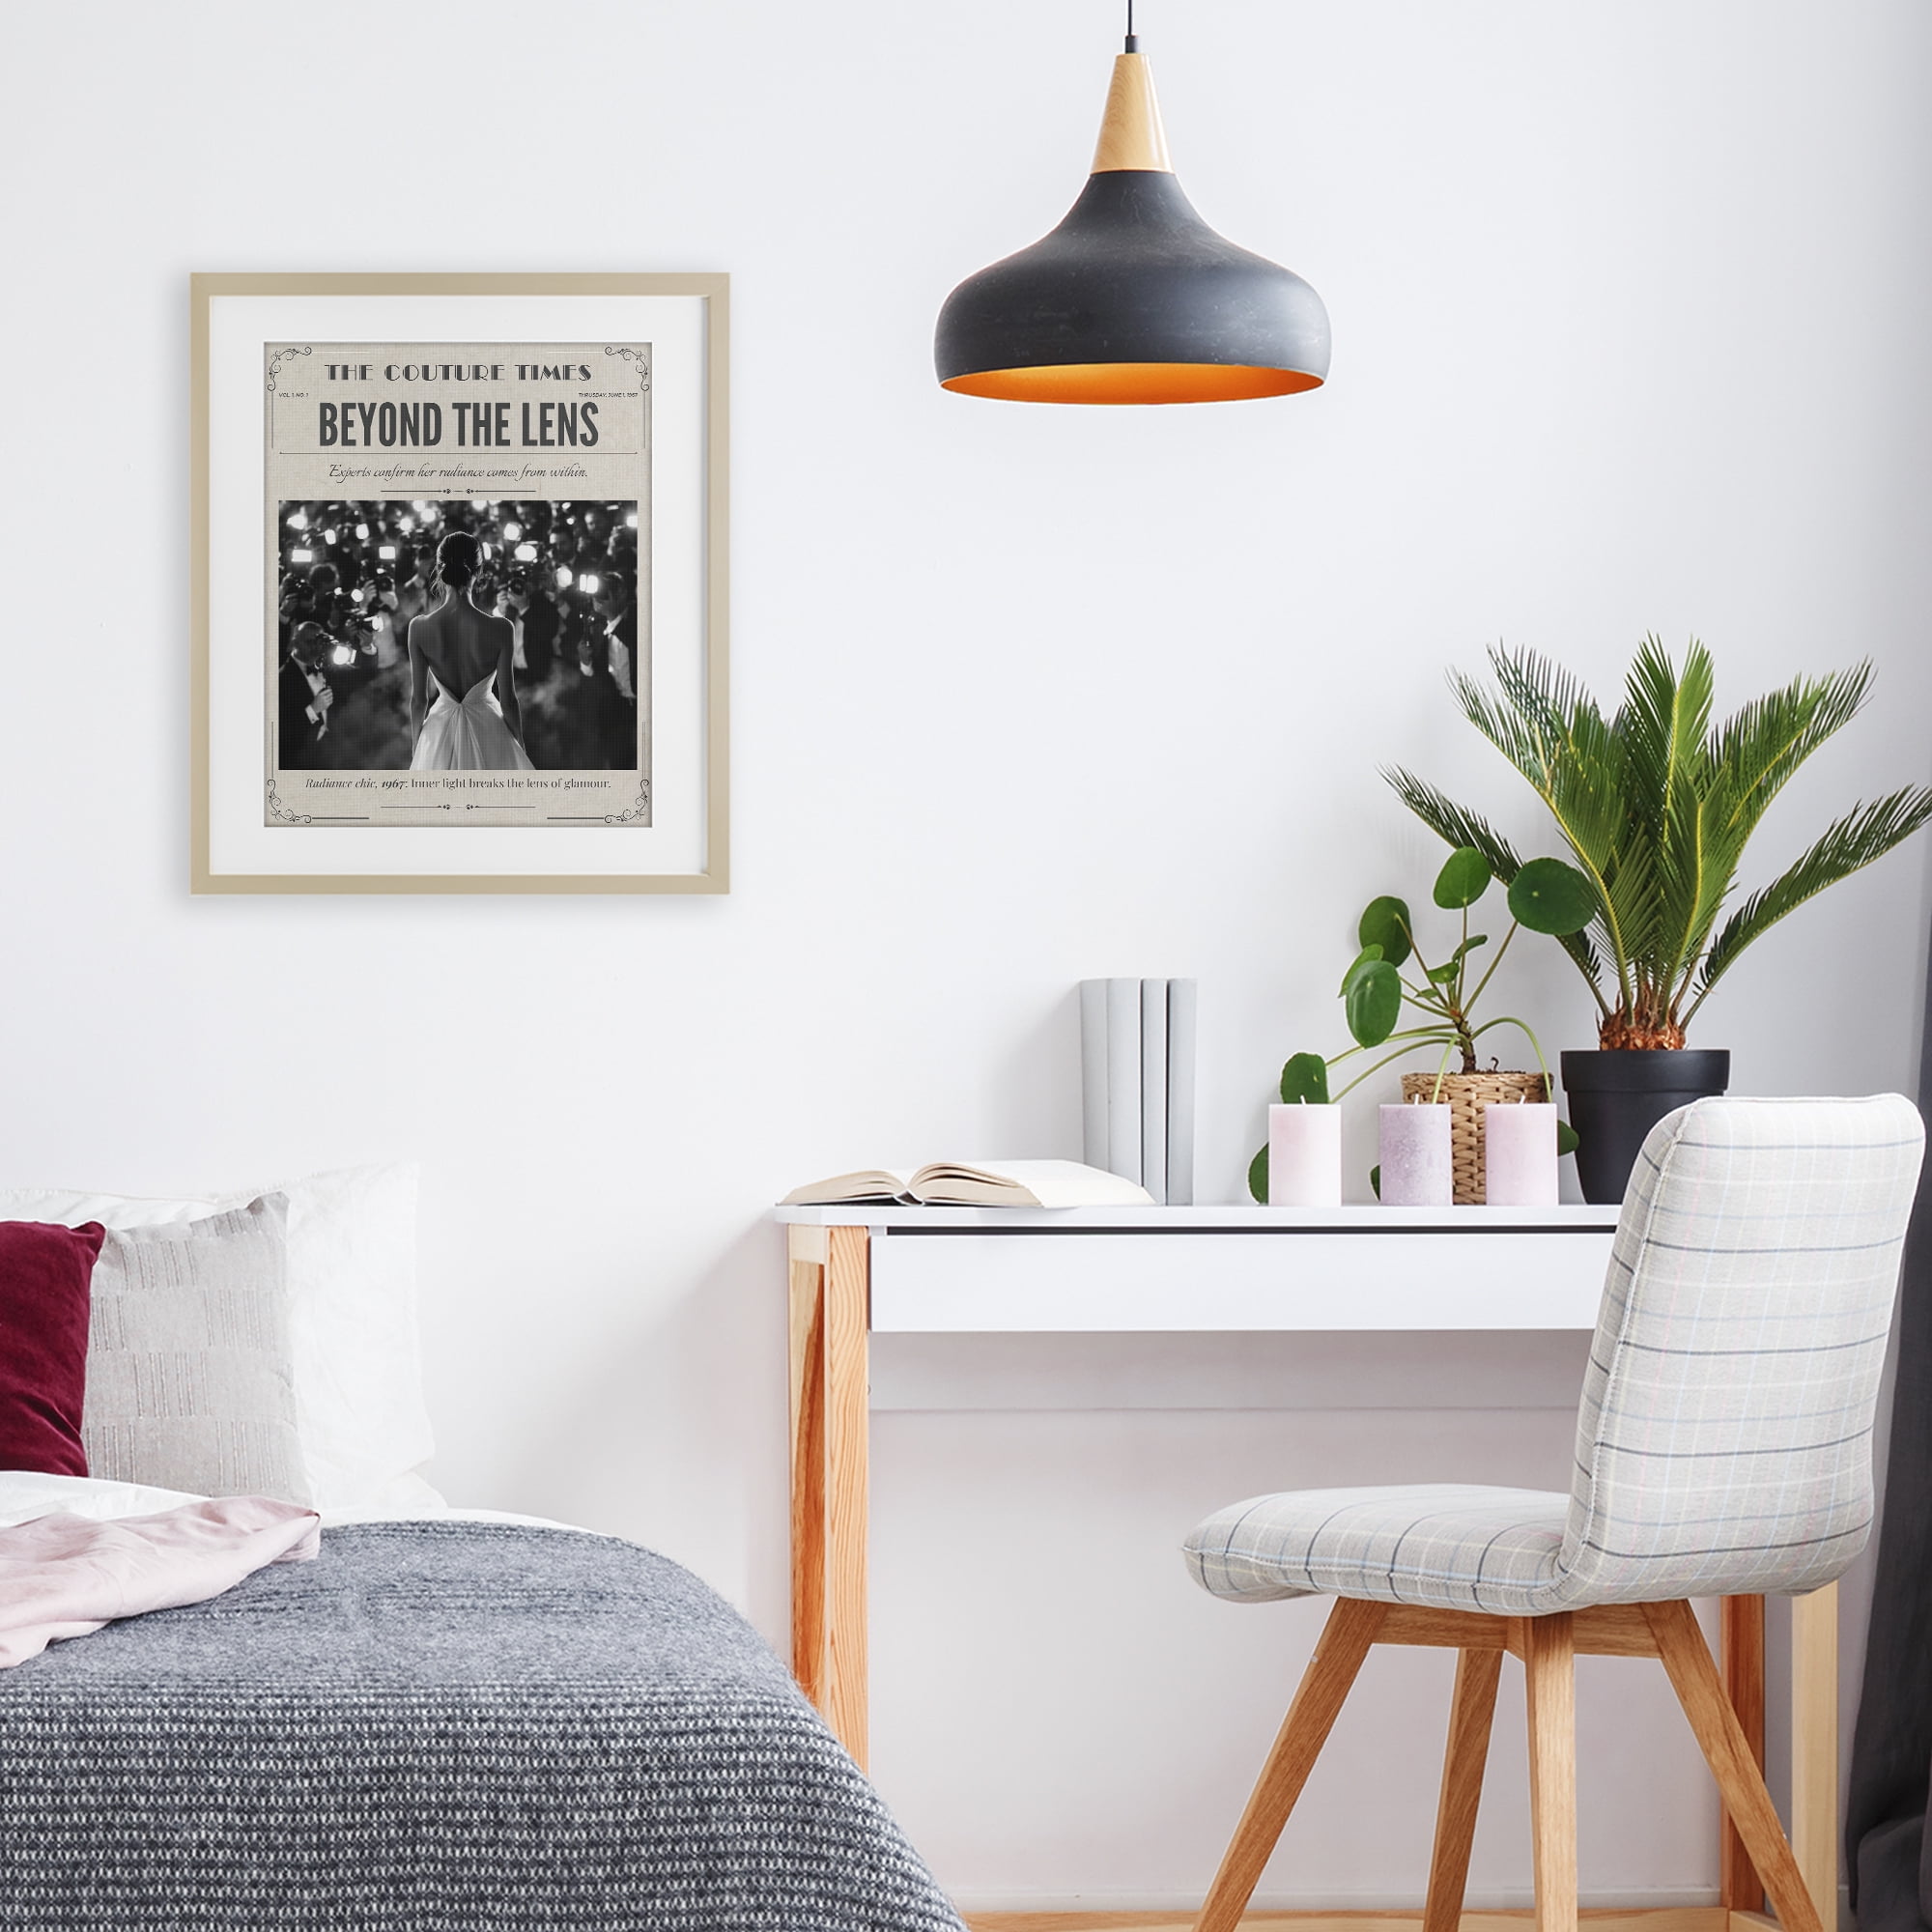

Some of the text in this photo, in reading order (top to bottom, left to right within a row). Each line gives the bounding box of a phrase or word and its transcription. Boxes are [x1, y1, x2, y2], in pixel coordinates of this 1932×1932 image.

[325, 364, 592, 382] THE COUTURE TIMES
[319, 402, 599, 447] BEYOND THE LENS
[328, 462, 588, 483] Experts confirm her radiance comes from within.
[305, 779, 353, 788] Radiance
[355, 779, 378, 789] chic,
[412, 779, 440, 788] Inner
[442, 779, 466, 789] light
[469, 779, 504, 788] breaks
[507, 779, 525, 788] the
[526, 779, 549, 788] lens
[551, 779, 563, 788] of
[563, 779, 611, 790] glamour.
